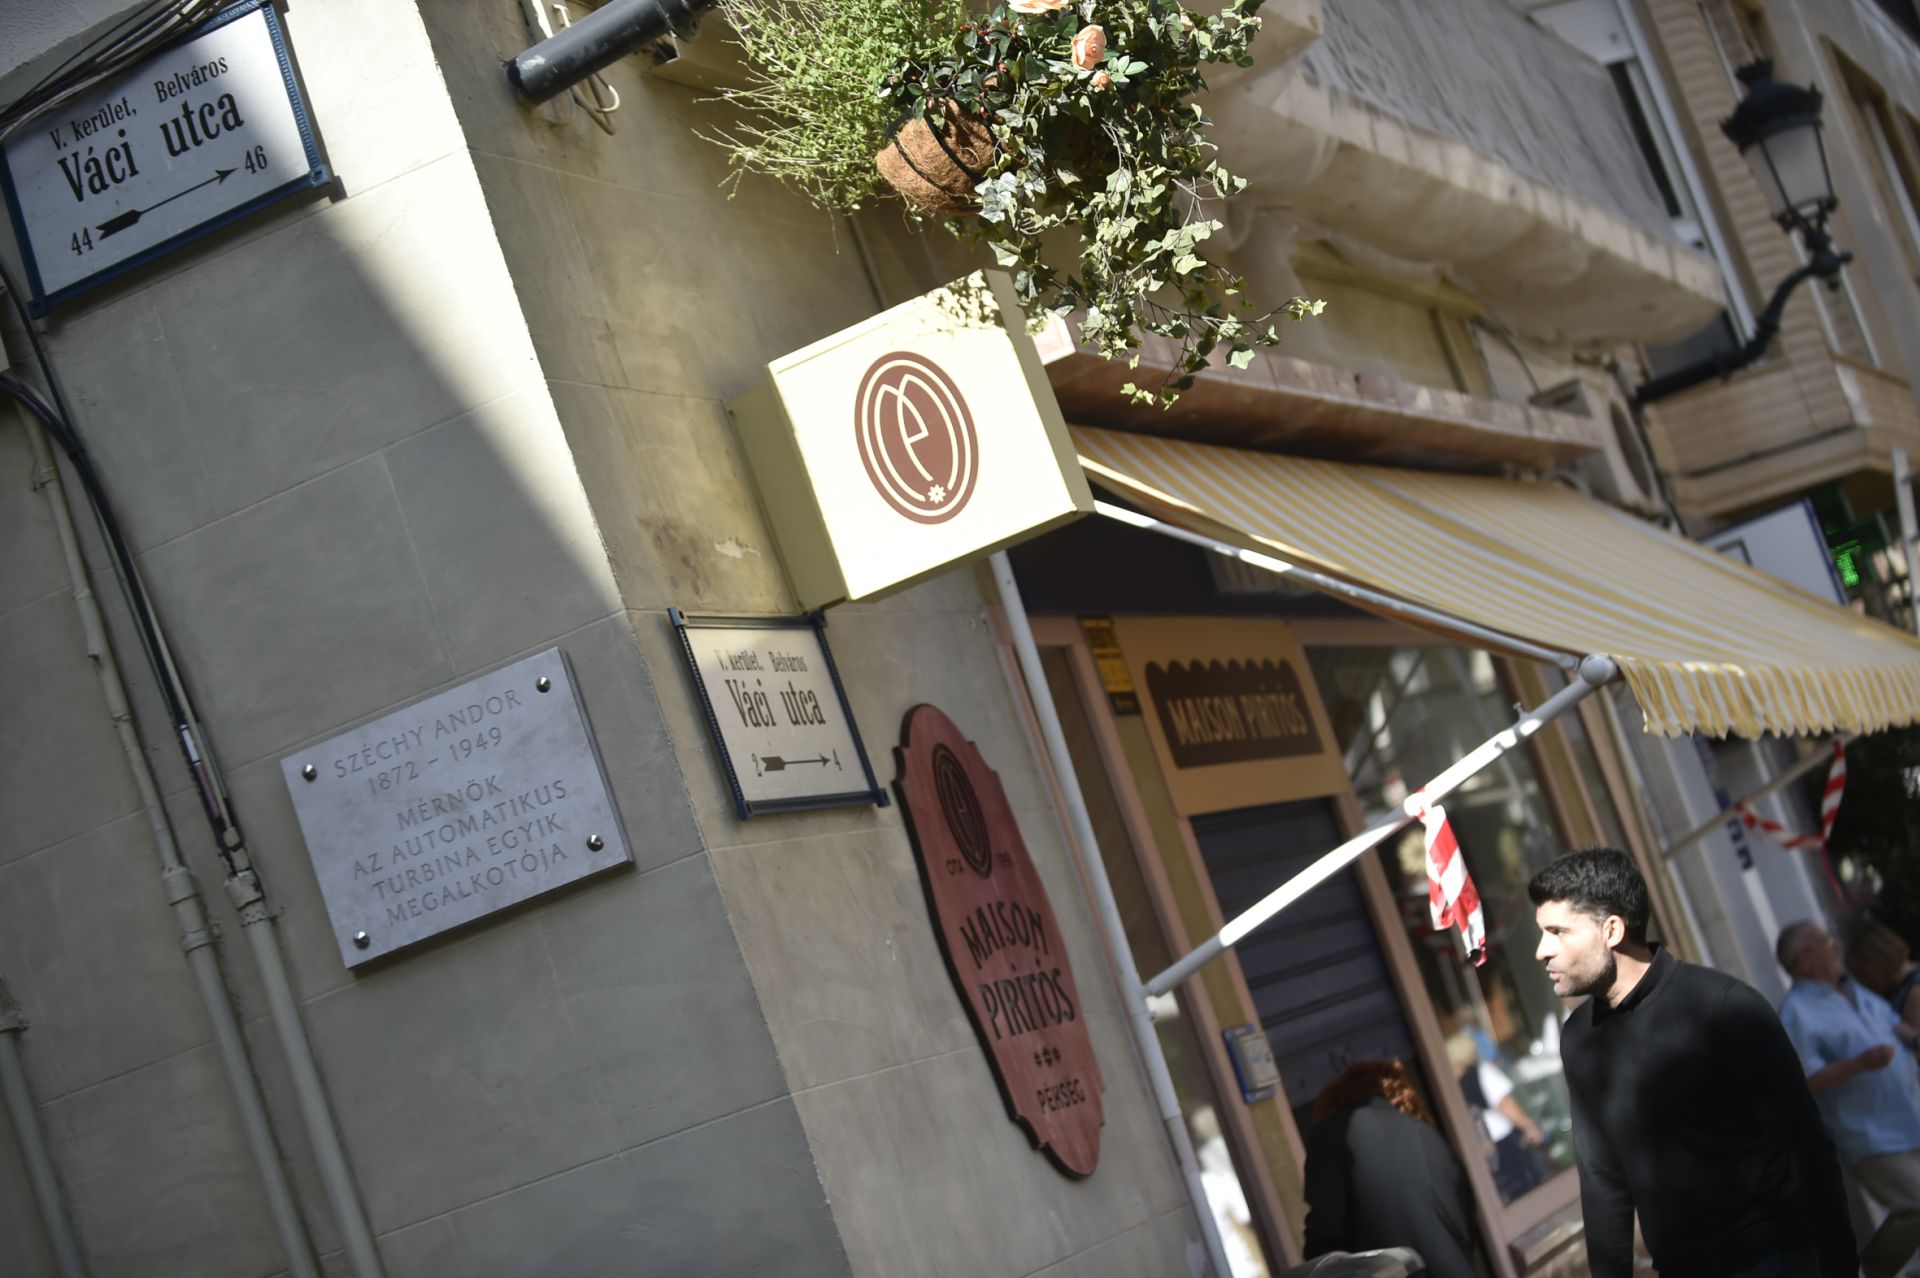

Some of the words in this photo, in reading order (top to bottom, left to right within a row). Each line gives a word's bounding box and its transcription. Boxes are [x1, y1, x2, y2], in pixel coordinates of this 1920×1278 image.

[50, 130, 68, 151] V.
[73, 96, 138, 142] kerület,
[154, 56, 229, 104] Belváros
[57, 129, 140, 203] Váci
[159, 91, 245, 158] utca
[70, 227, 95, 256] 44
[243, 145, 269, 175] 46
[725, 677, 777, 728] Váci
[779, 680, 827, 727] utca
[767, 650, 809, 673] Belváros
[333, 724, 426, 779] SZÉCHY
[434, 689, 522, 740] ANDOR
[367, 760, 420, 796] 1872
[448, 725, 503, 763] 1949
[1166, 694, 1249, 746] MAISON
[353, 852, 386, 881] AZ
[391, 779, 569, 866] AUTOMATIKUS
[396, 774, 504, 831] MÉRNÖK
[372, 845, 483, 901] TURBINA
[486, 812, 564, 858] EGYIK
[385, 842, 570, 928] MEGALKOTÓJA
[959, 900, 1050, 971] MAISON
